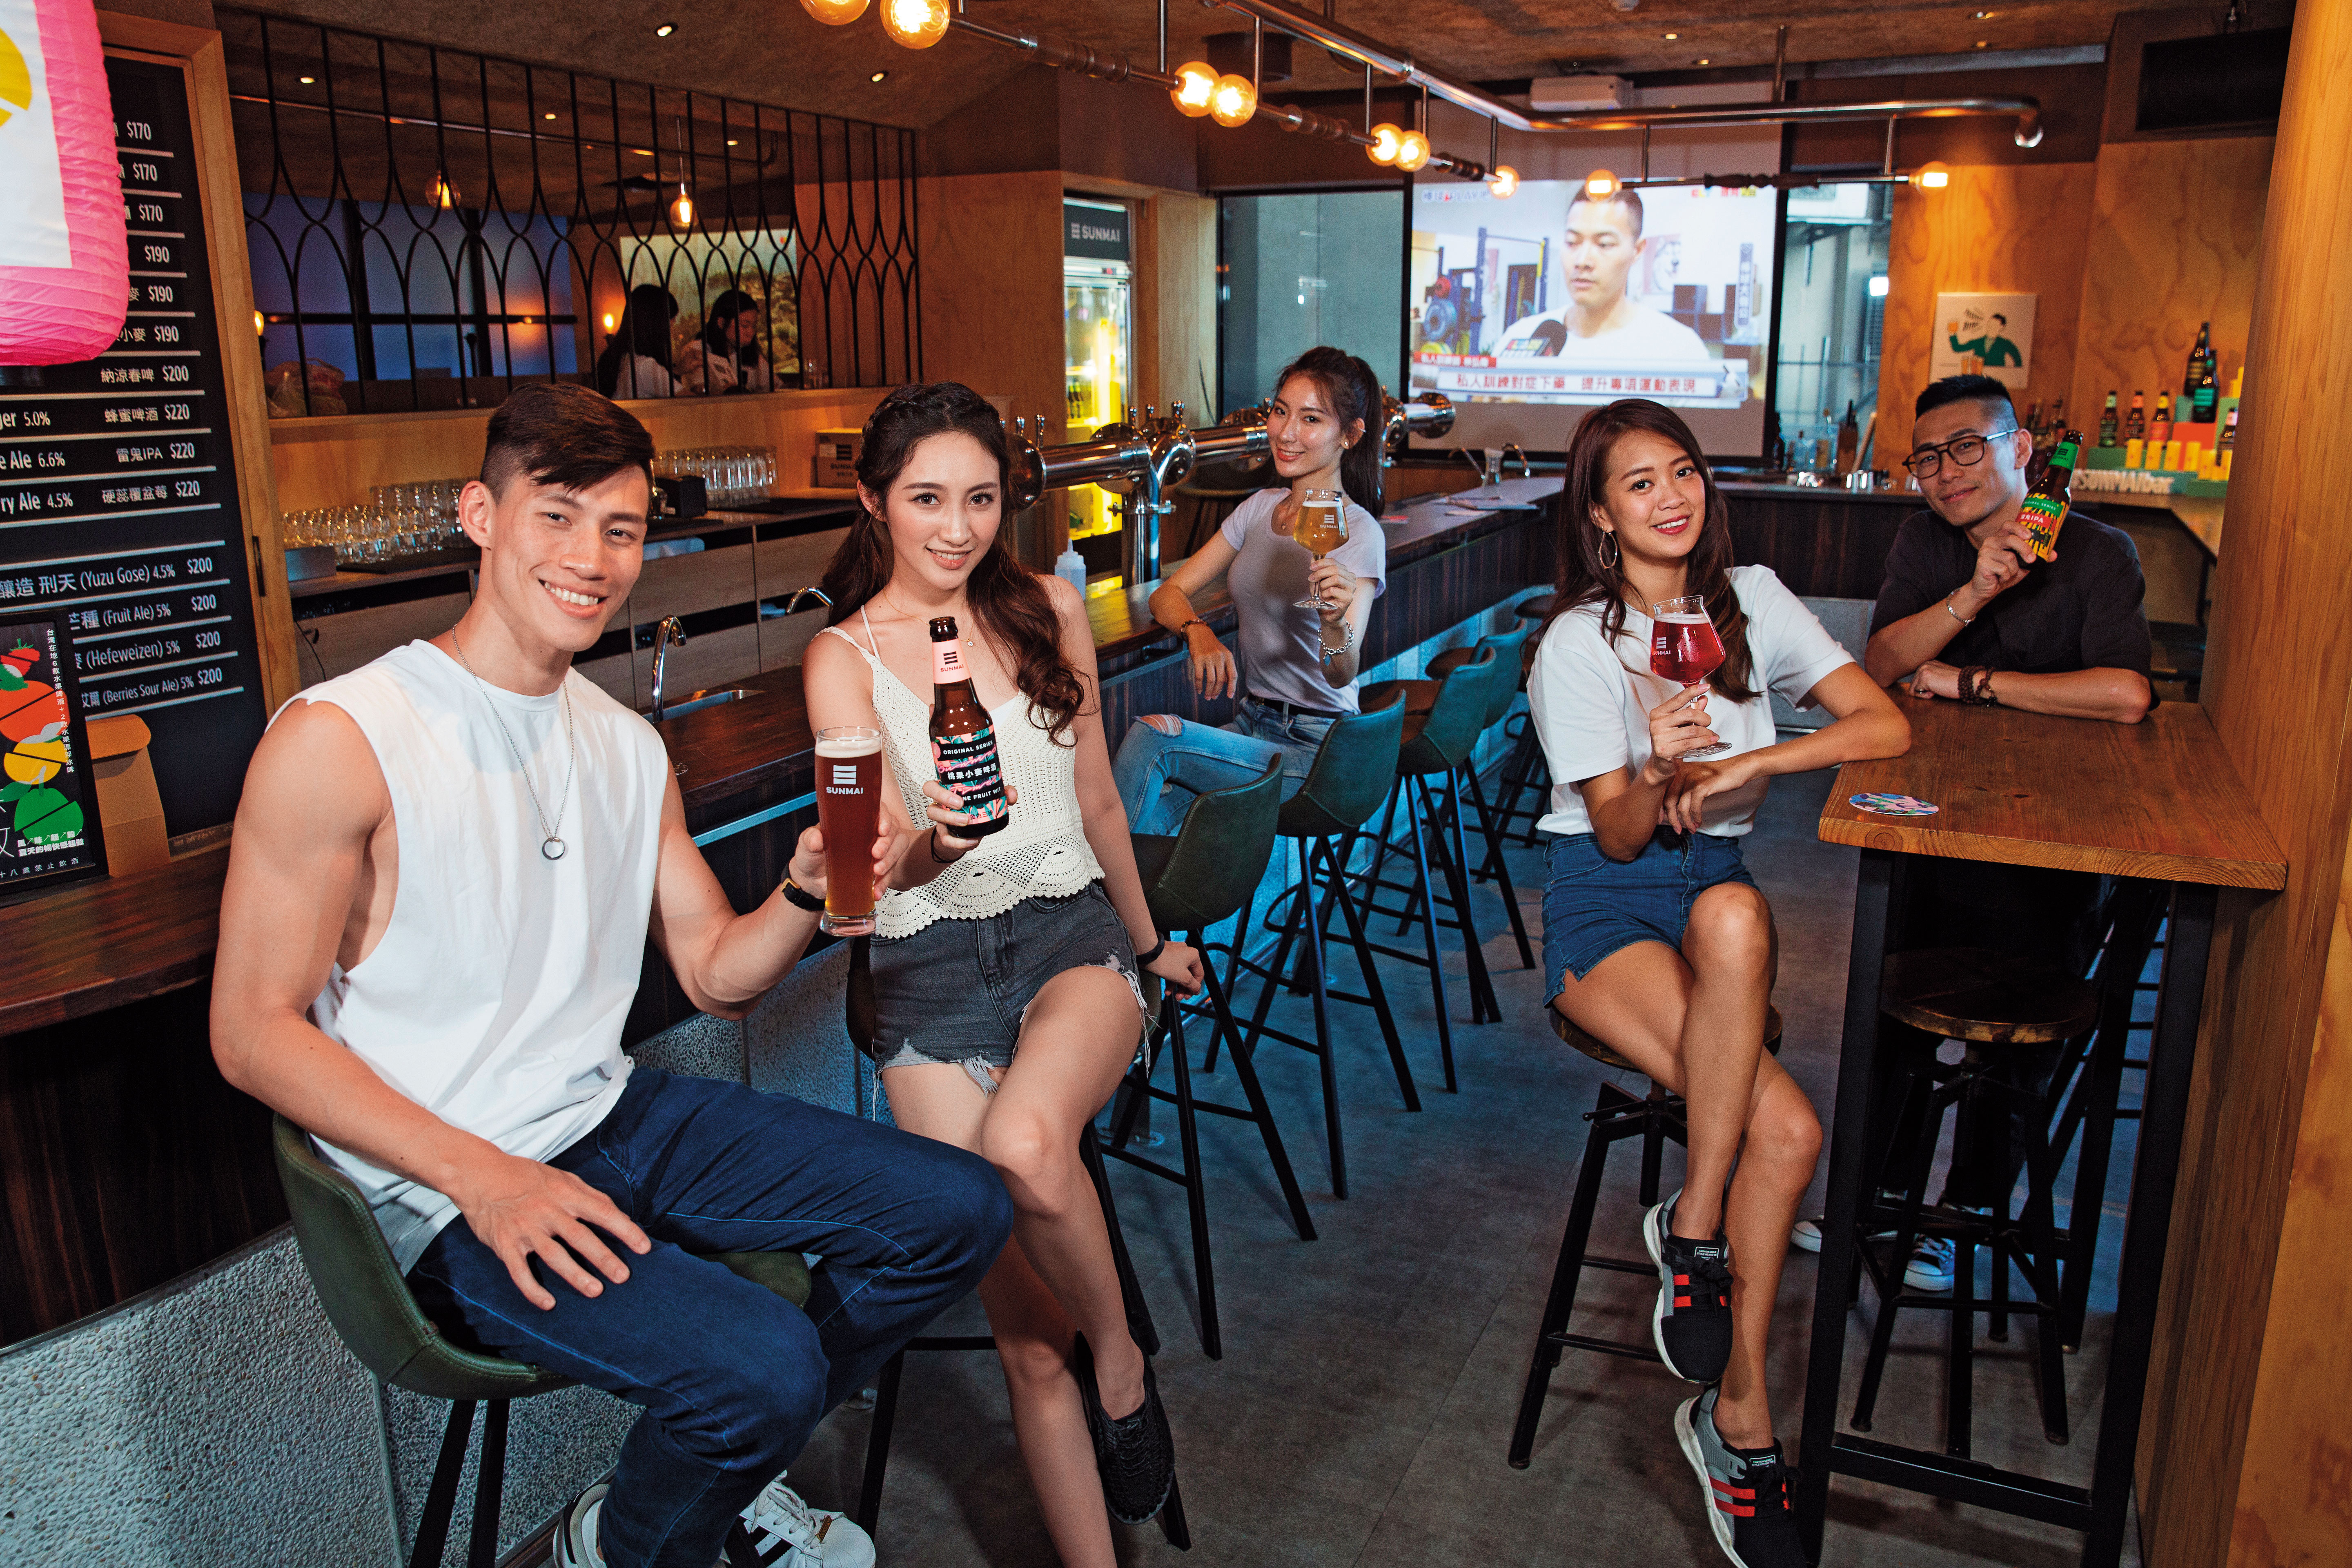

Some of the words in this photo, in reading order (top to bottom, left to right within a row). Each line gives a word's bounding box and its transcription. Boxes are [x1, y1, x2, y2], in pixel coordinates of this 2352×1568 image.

[127, 120, 151, 140] $170
[133, 162, 158, 182] $170
[139, 203, 163, 222] $170
[1082, 225, 1120, 243] SUNMAI
[144, 245, 170, 263] $190
[148, 284, 174, 303] $190
[117, 327, 146, 342] 小麥
[154, 325, 180, 342] $190
[100, 367, 155, 383] 納涼春啤
[162, 365, 189, 382] $200
[24, 411, 51, 427] 5.0%
[105, 407, 159, 423] 蜂蜜啤酒
[164, 403, 190, 421] $220
[10, 450, 32, 470] Ale
[38, 451, 66, 468] 6.6%
[116, 446, 163, 463] 雷鬼IPA
[169, 441, 195, 460] $220
[20, 492, 41, 511] Ale
[47, 492, 74, 508] 4.5%
[175, 480, 200, 498] $220
[38, 572, 77, 595] 刑天
[80, 570, 115, 591] (Yuzu
[117, 565, 150, 585] Gose)
[152, 564, 176, 580] 4.5%
[187, 556, 213, 576] $200
[102, 607, 132, 627] (Fruit
[134, 604, 154, 621] Ale)
[156, 603, 172, 618] 5%
[191, 593, 217, 612] $200
[86, 640, 163, 670] (Hefeweizen)
[165, 640, 180, 655] 5%
[195, 630, 221, 649] $200
[940, 664, 964, 672] SUNMAI
[103, 687, 138, 705] (Berries
[139, 681, 160, 697] Sour
[162, 678, 180, 693] Ale)
[180, 675, 194, 690] 5%
[198, 667, 223, 686] $200
[976, 740, 993, 750] SERIES
[947, 763, 997, 780] 桃果小麥啤酒
[826, 786, 864, 795] SUNMAI
[973, 791, 991, 800] FRUIT
